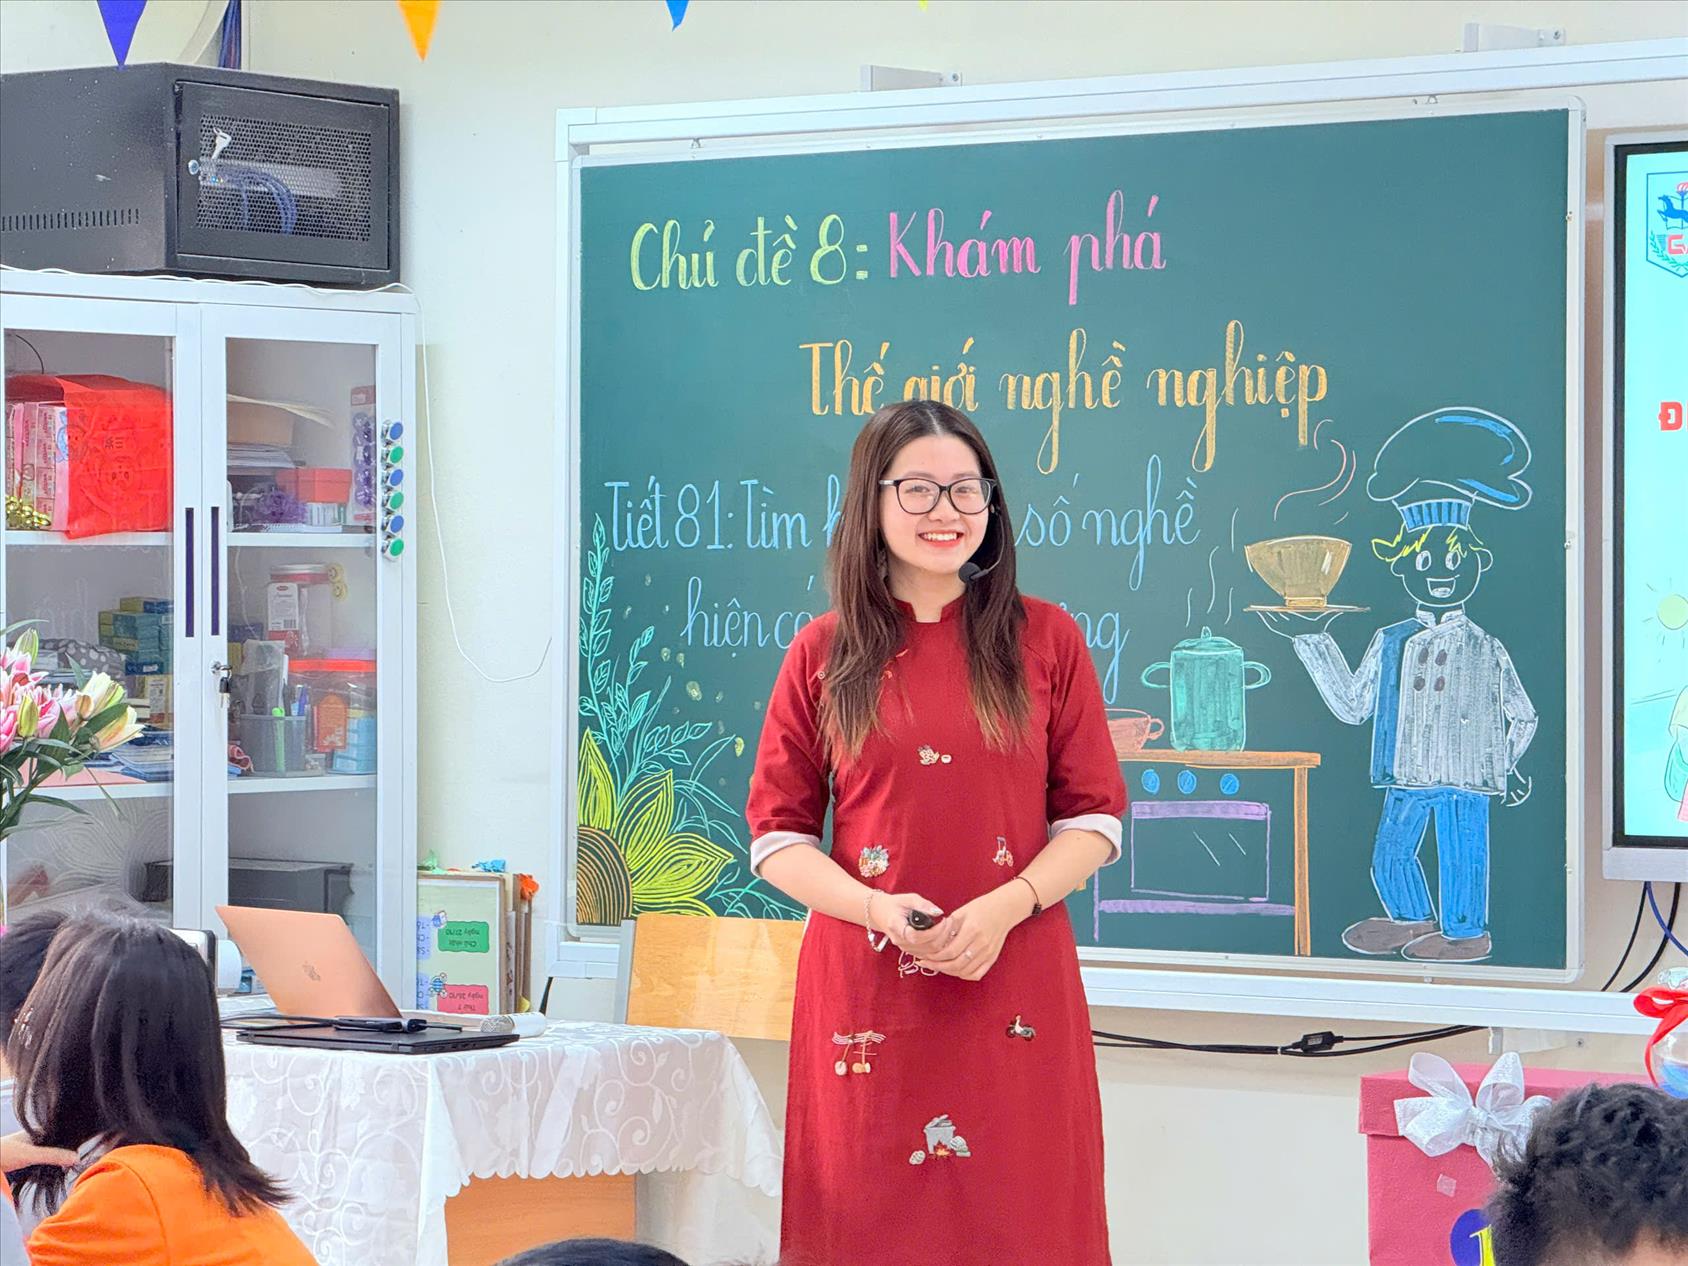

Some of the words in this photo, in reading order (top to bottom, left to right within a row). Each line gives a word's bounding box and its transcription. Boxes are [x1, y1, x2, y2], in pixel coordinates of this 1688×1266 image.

[631, 218, 720, 291] Chủ
[735, 214, 799, 287] đề
[809, 213, 869, 286] 8:
[889, 208, 1041, 279] Khám
[1063, 189, 1167, 305] phá
[799, 338, 890, 416] Thế
[1000, 327, 1126, 475] nghề
[1146, 320, 1328, 473] nghiệp
[604, 475, 670, 551] Tiết
[675, 480, 733, 549] 81:
[740, 479, 813, 550] Tìm
[1015, 472, 1079, 546] số
[1081, 454, 1201, 592] nghề
[680, 576, 770, 659] hiện
